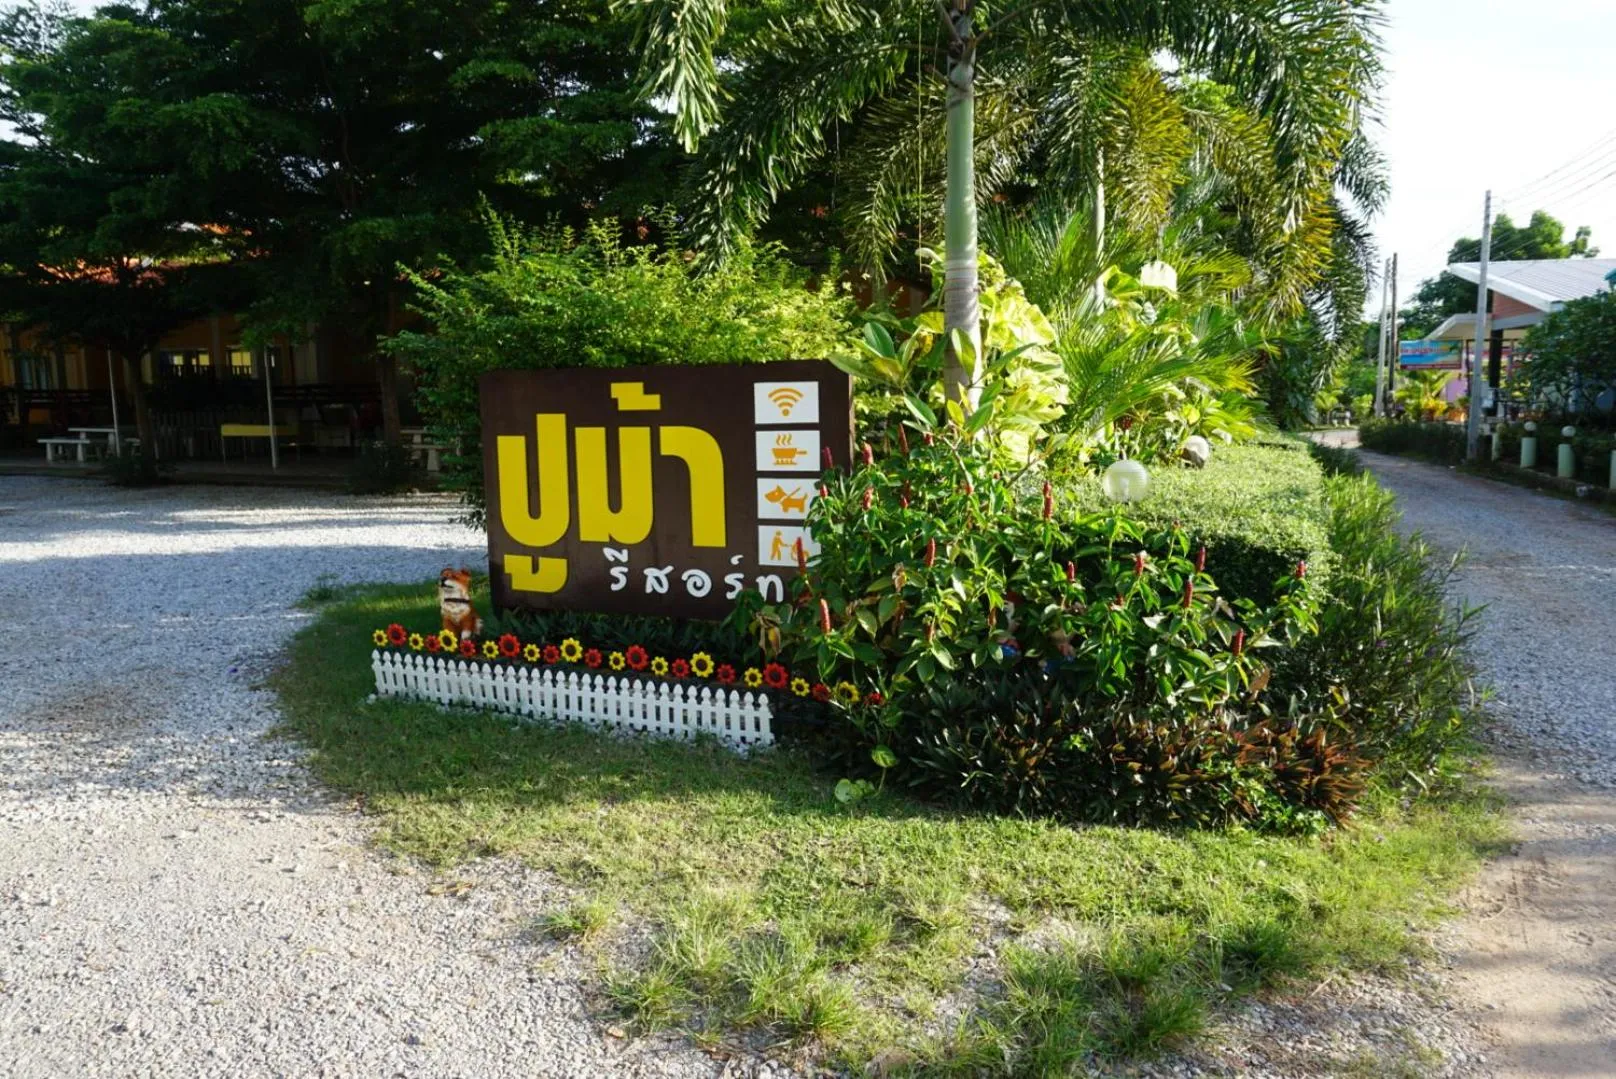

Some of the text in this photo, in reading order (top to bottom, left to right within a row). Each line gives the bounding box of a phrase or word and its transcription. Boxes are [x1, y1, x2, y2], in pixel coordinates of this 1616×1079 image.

[497, 381, 727, 593] ปูม้า
[602, 546, 785, 603] รีสอร์ท
